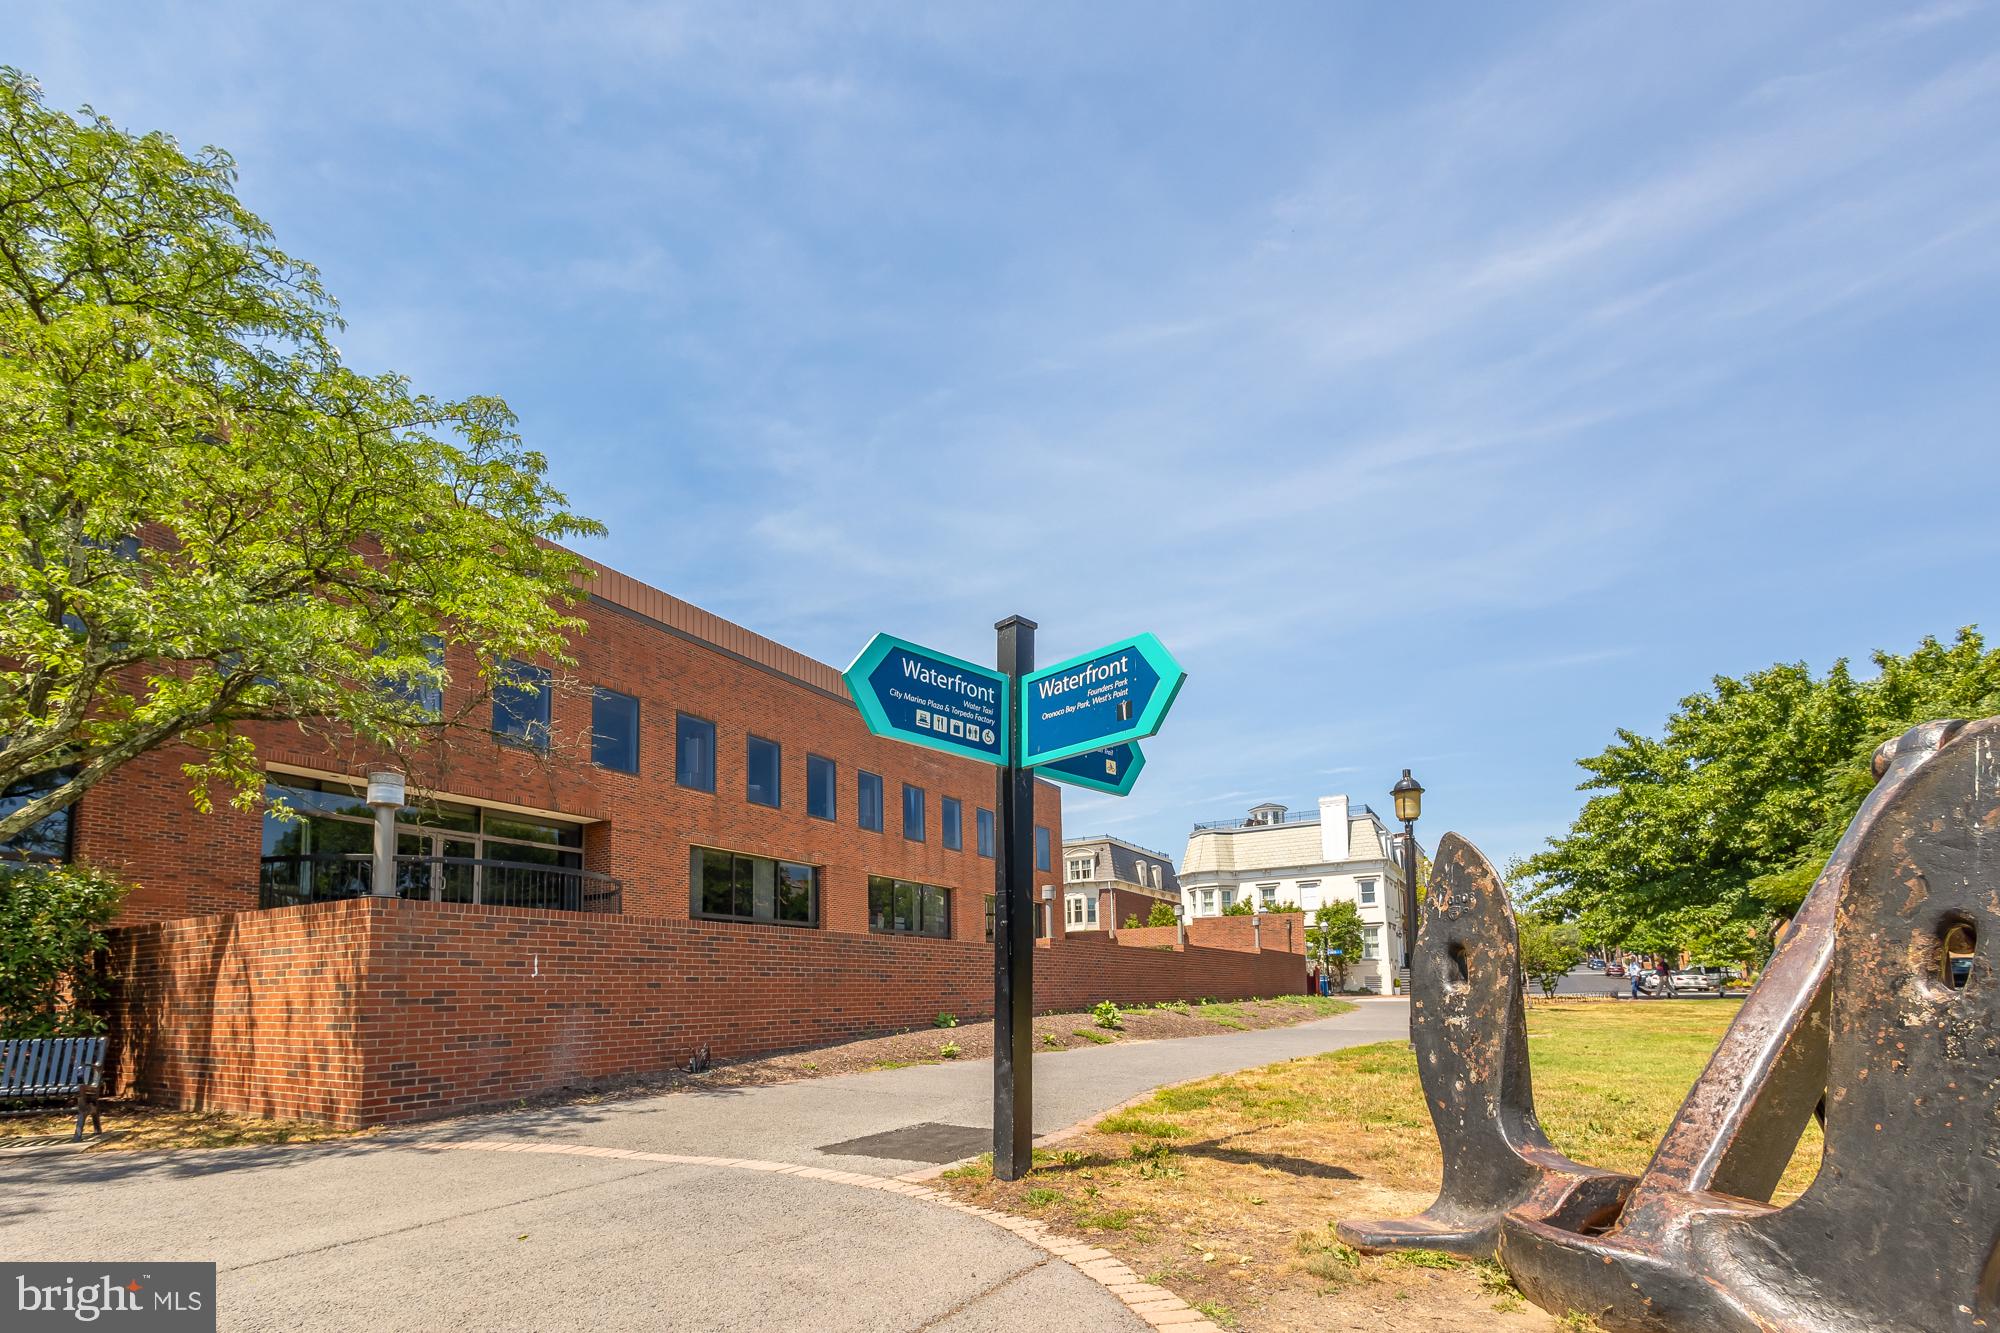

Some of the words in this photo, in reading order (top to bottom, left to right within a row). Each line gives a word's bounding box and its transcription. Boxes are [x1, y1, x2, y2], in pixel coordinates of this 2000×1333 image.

[902, 657, 995, 704] Waterfront
[1038, 656, 1128, 699] Waterfront
[1087, 683, 1113, 697] Founders
[1114, 677, 1128, 688] Park
[889, 688, 902, 699] City
[903, 692, 926, 705] Marina
[927, 699, 944, 710] Plaza
[944, 704, 950, 712] &
[951, 706, 974, 719] Torpedo
[974, 713, 996, 726] Factory
[963, 700, 981, 711] Water
[982, 706, 994, 715] Taxi
[1041, 709, 1064, 720] Oronoco
[1065, 704, 1076, 714] Bay
[1077, 700, 1091, 709] Park,
[1092, 693, 1112, 704] West's
[1112, 688, 1128, 699] Point
